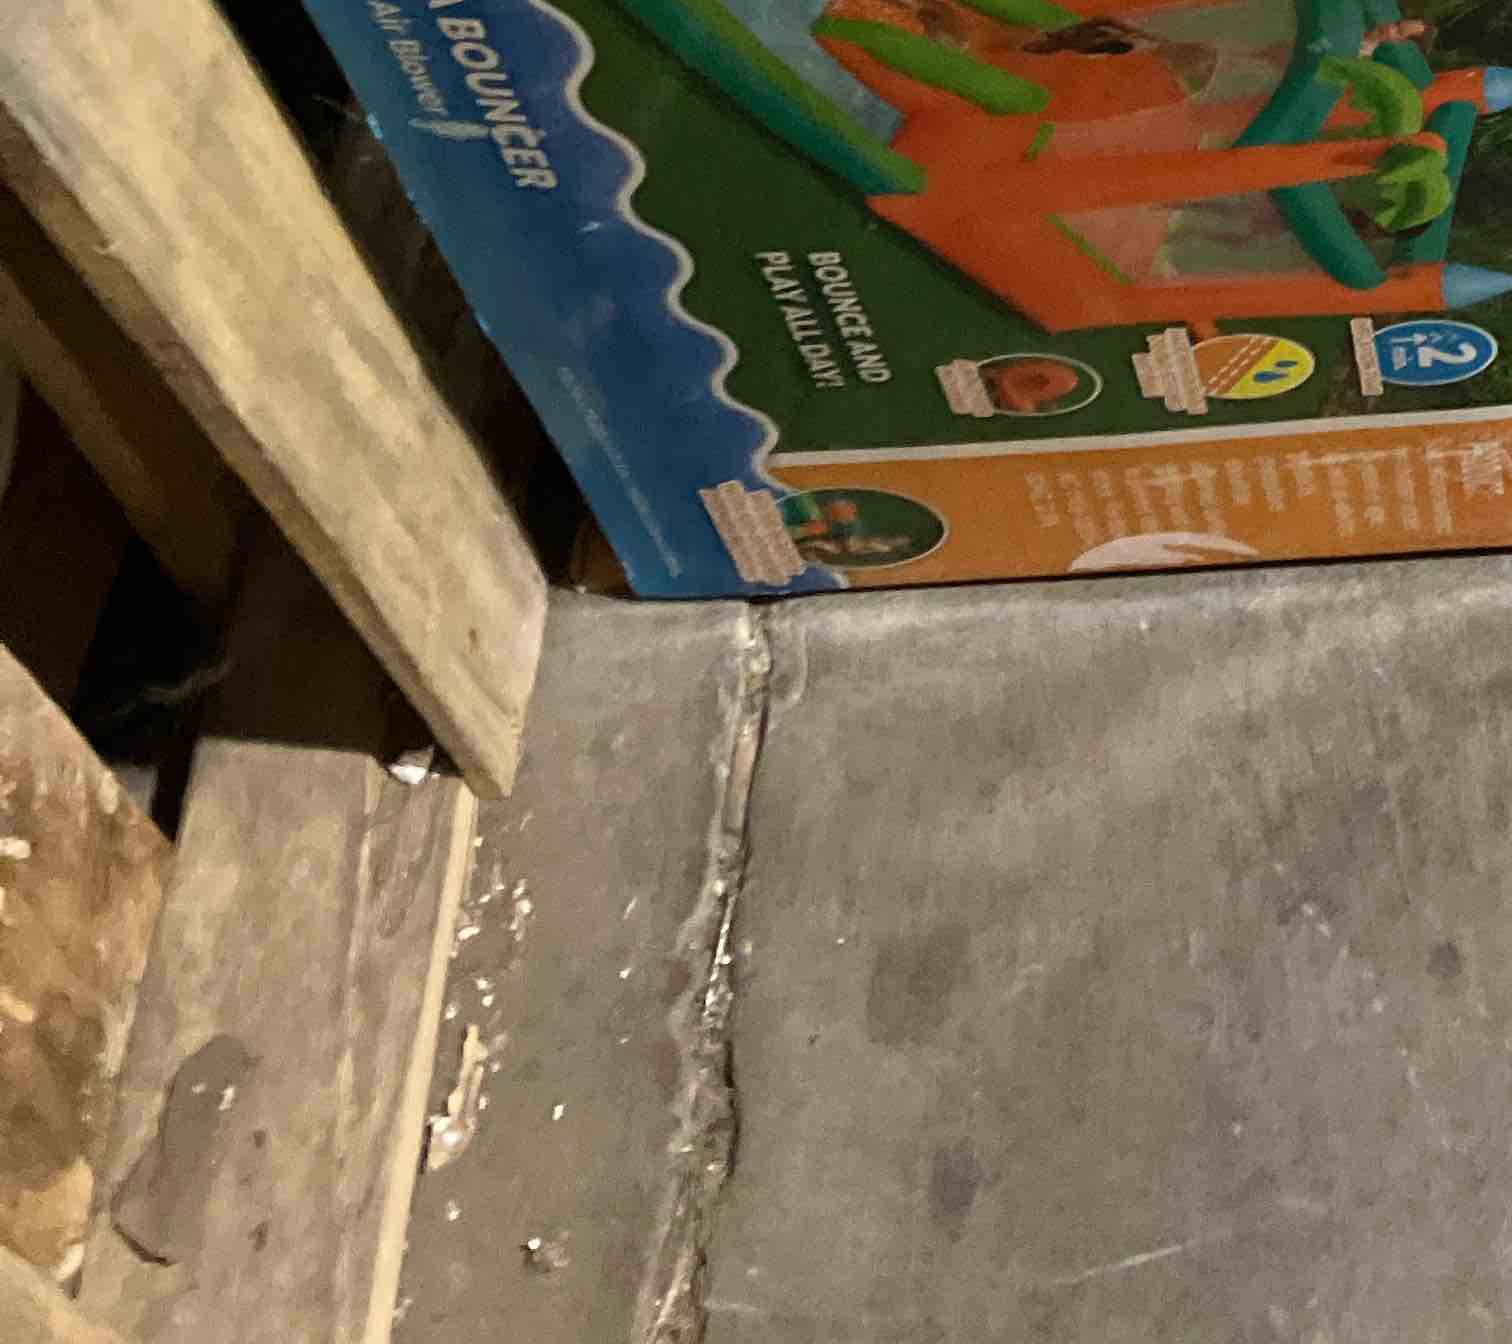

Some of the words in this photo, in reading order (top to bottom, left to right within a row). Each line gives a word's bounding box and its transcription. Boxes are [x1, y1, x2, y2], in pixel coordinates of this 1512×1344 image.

[436, 16, 558, 191] BOUNCER
[754, 251, 809, 303] PLAY
[780, 305, 824, 343] ALL
[807, 251, 873, 339] BOUNCE
[845, 340, 892, 383] AND
[798, 343, 847, 389] DAY!
